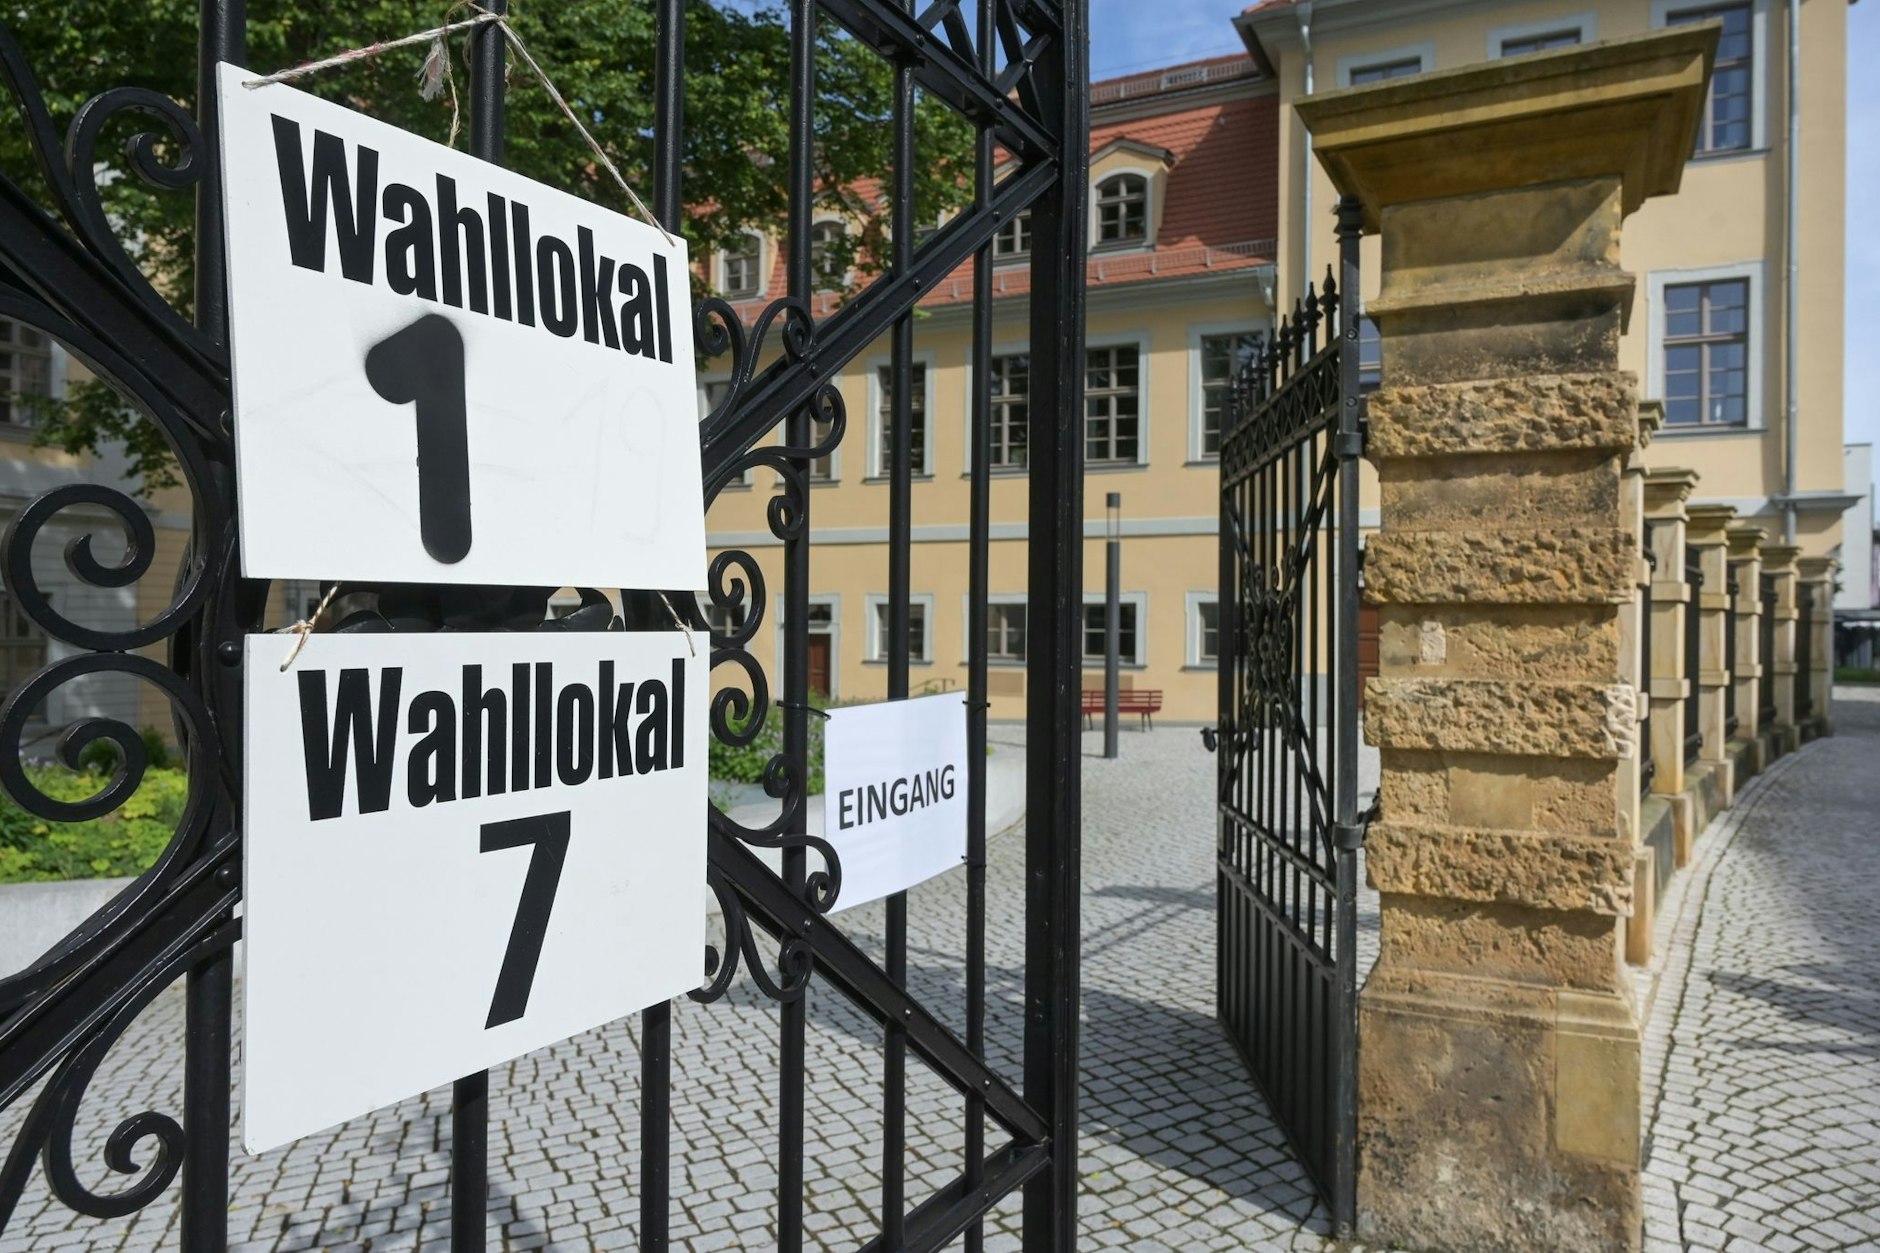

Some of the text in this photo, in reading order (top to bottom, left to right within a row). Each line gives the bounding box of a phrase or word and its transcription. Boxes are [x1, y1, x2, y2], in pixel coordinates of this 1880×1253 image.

[270, 112, 673, 364] Wahllokal
[365, 313, 472, 564] 1
[297, 657, 685, 821] Wahllokal
[839, 764, 955, 831] EINGANG
[479, 810, 571, 1031] 7
